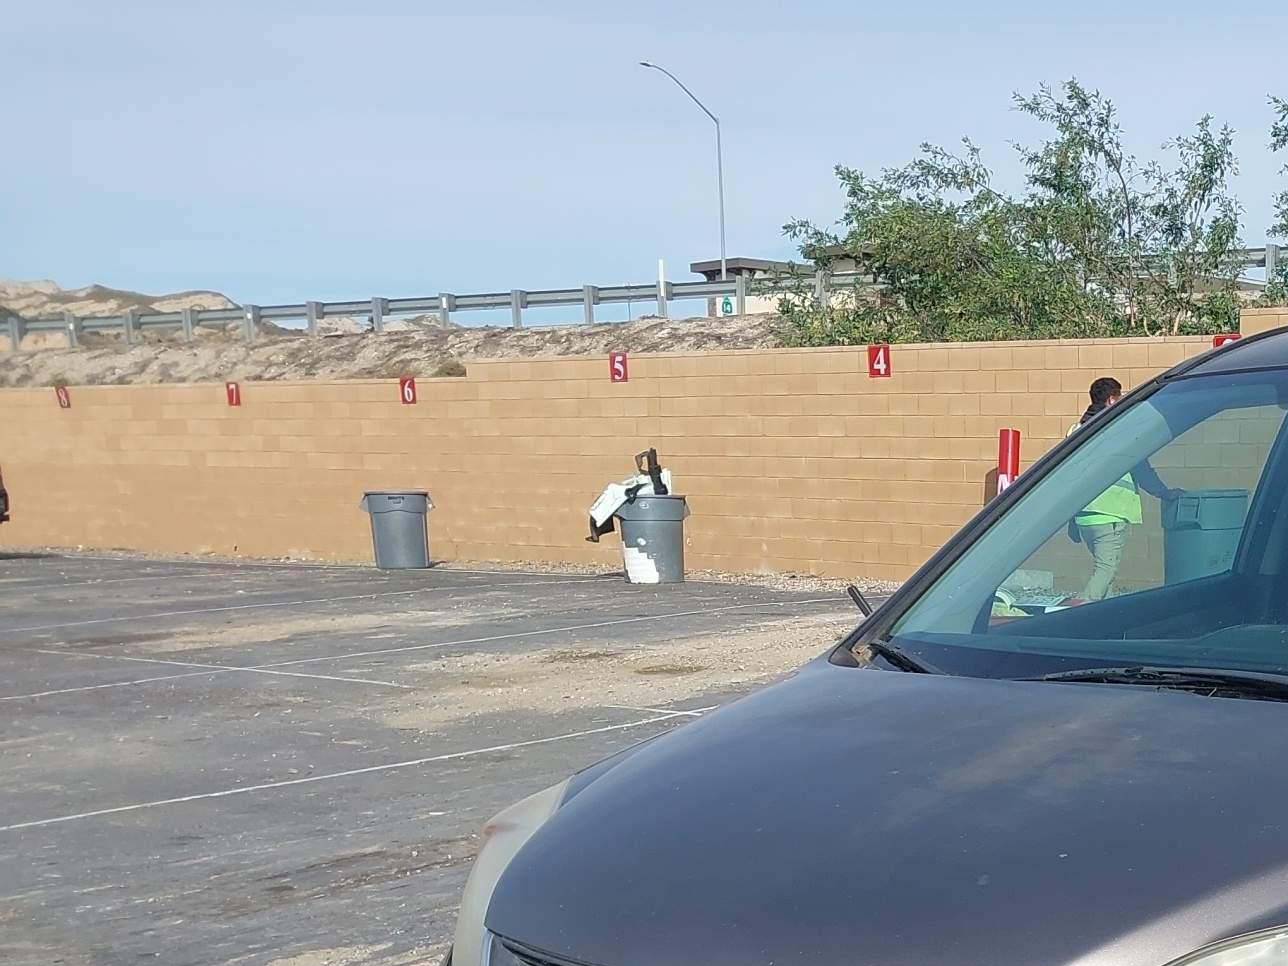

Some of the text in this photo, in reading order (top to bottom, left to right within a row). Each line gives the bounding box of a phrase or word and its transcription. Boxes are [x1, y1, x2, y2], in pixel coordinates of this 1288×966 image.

[613, 355, 624, 380] 5
[873, 347, 887, 375] 4
[58, 388, 68, 407] 8
[228, 383, 236, 405] 7
[404, 380, 413, 402] 6
